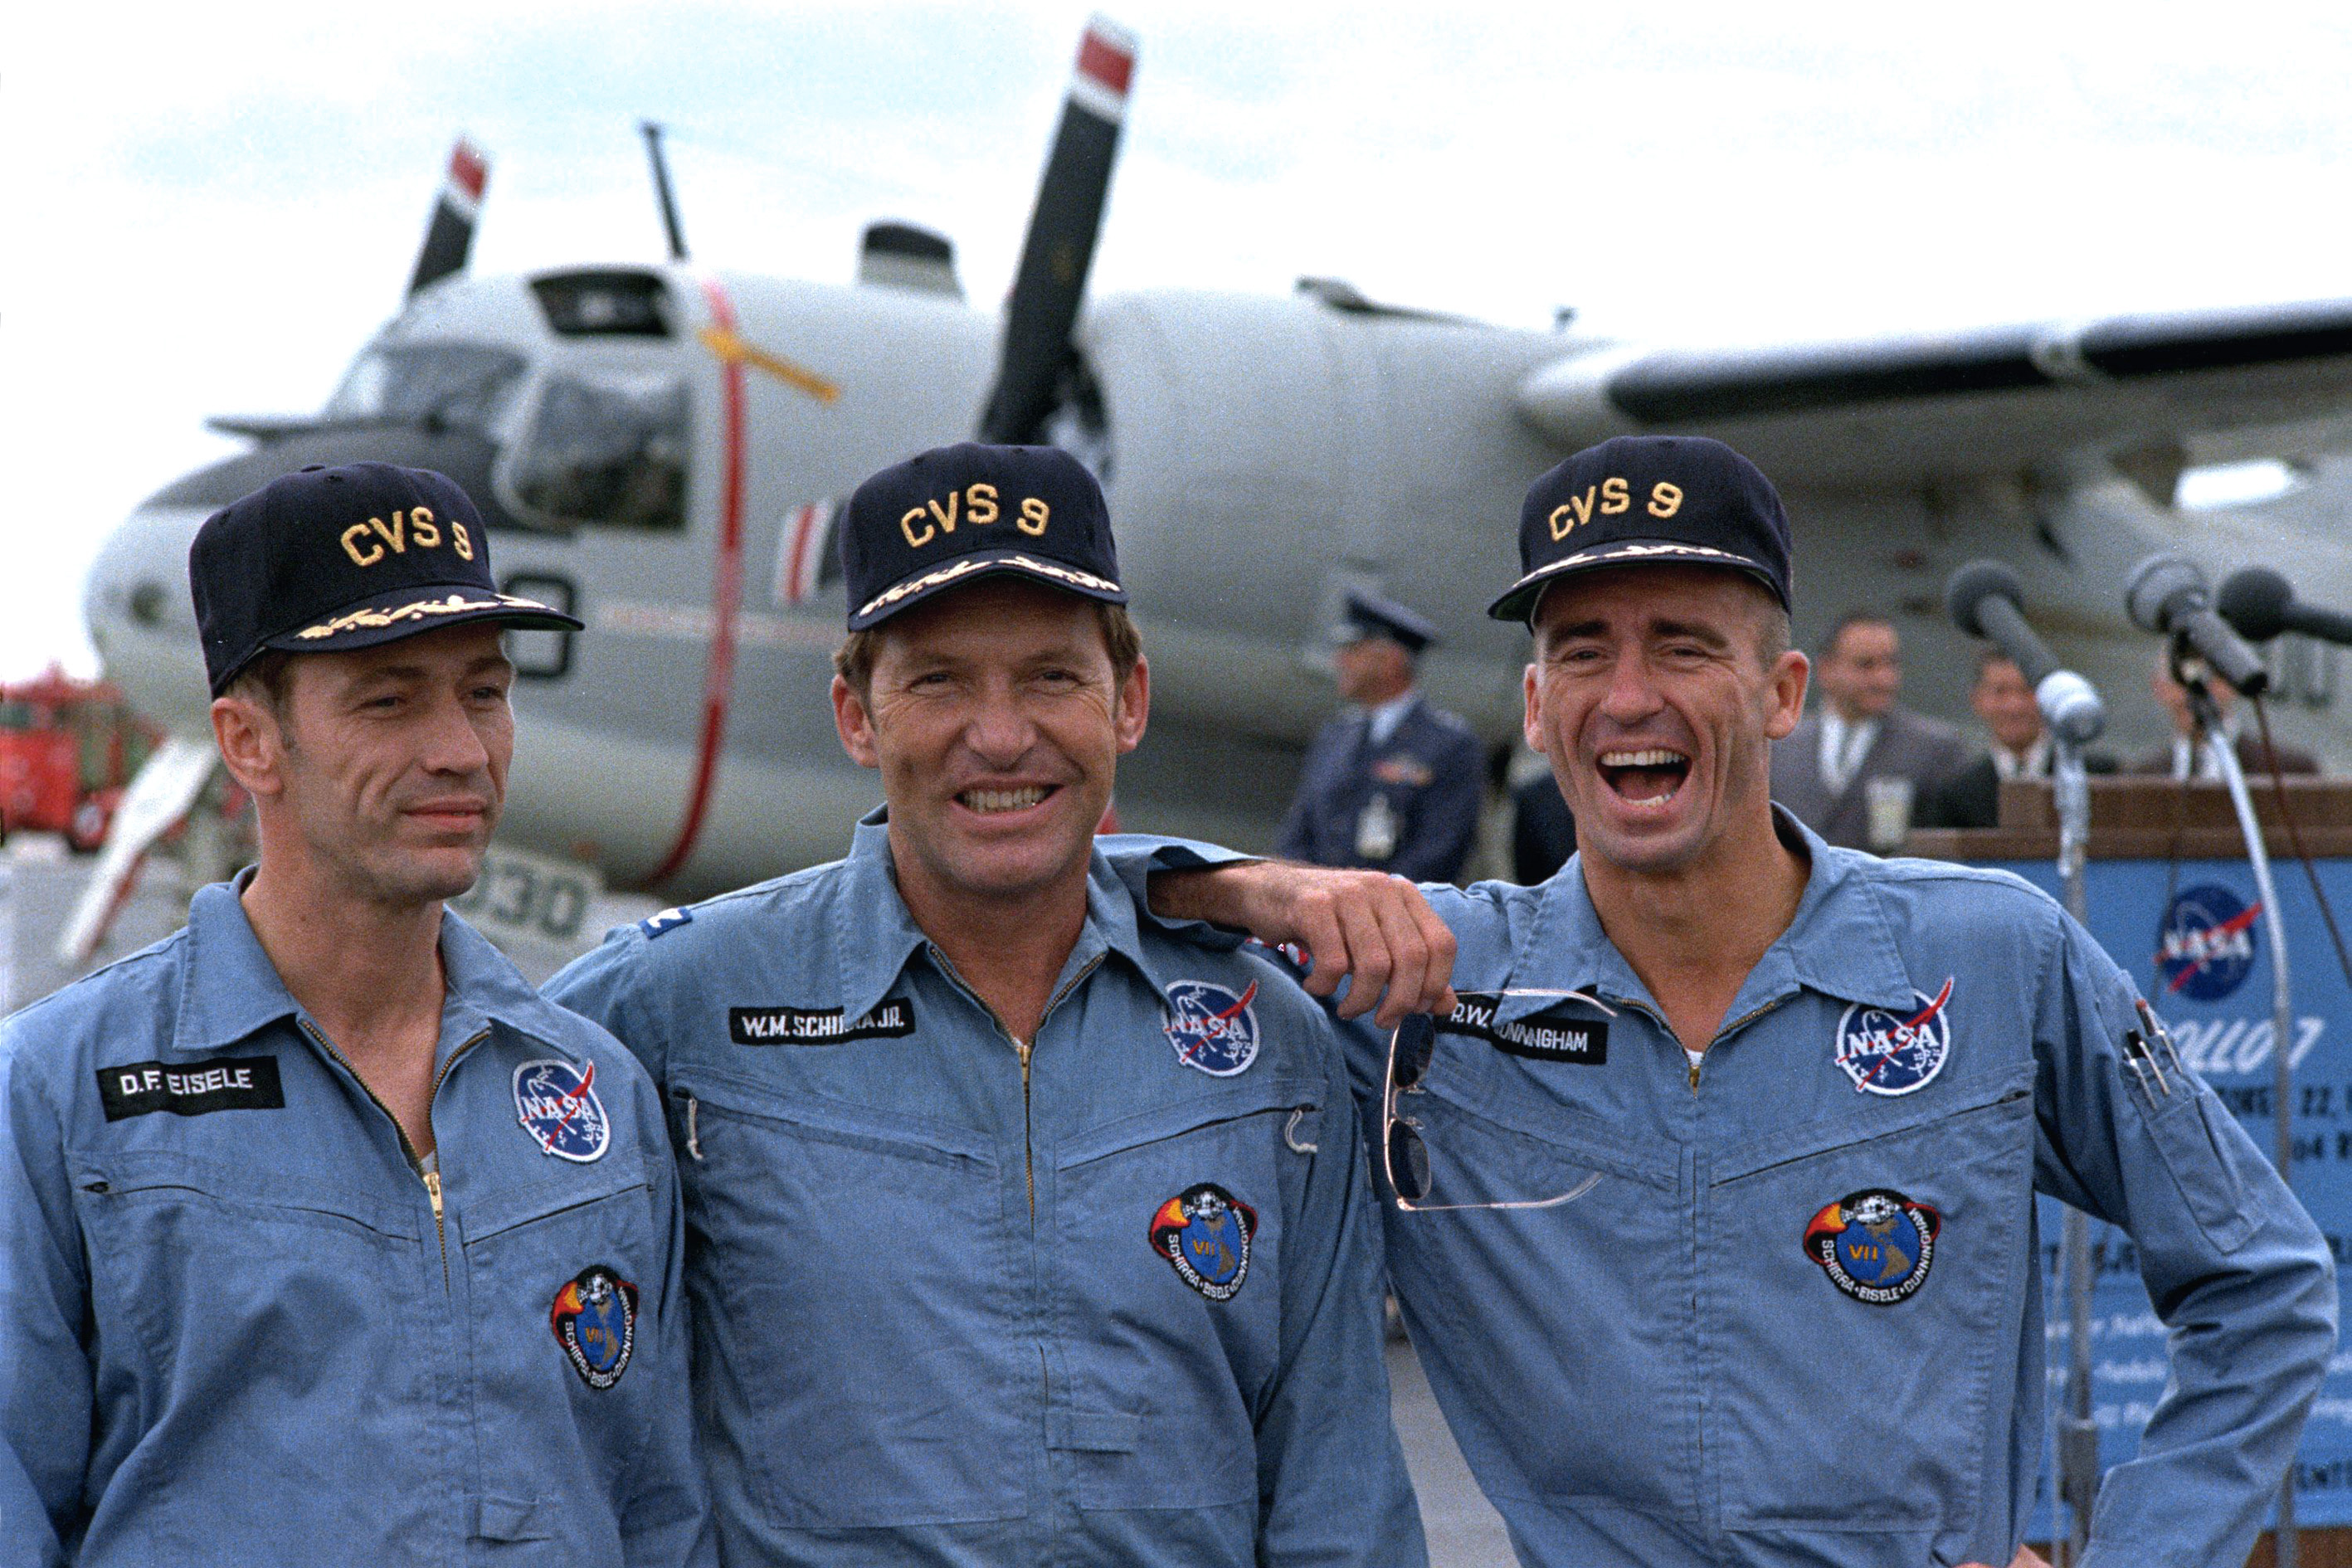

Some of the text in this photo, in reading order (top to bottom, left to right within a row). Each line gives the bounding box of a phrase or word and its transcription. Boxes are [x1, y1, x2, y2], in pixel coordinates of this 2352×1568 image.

[901, 483, 1049, 548] CVS 9
[1549, 477, 1684, 542] CVS 9
[340, 506, 474, 567] CVS 9
[2164, 926, 2252, 960] NASA
[741, 1015, 790, 1038] W.M.
[877, 1006, 905, 1029] JR.
[1170, 1011, 1249, 1040] NASA
[1450, 1003, 1493, 1028] R.W.
[1847, 1023, 1940, 1059] NASA
[2171, 1017, 2325, 1074] OLLO 7
[119, 1067, 254, 1096] D.F. EISELE
[520, 1095, 599, 1122] NASA
[1168, 1234, 1201, 1287] SCHIRRA
[1821, 1207, 1933, 1303] SCHIRRA EISELE CUNNINGHAM
[1848, 1244, 1878, 1262] VII
